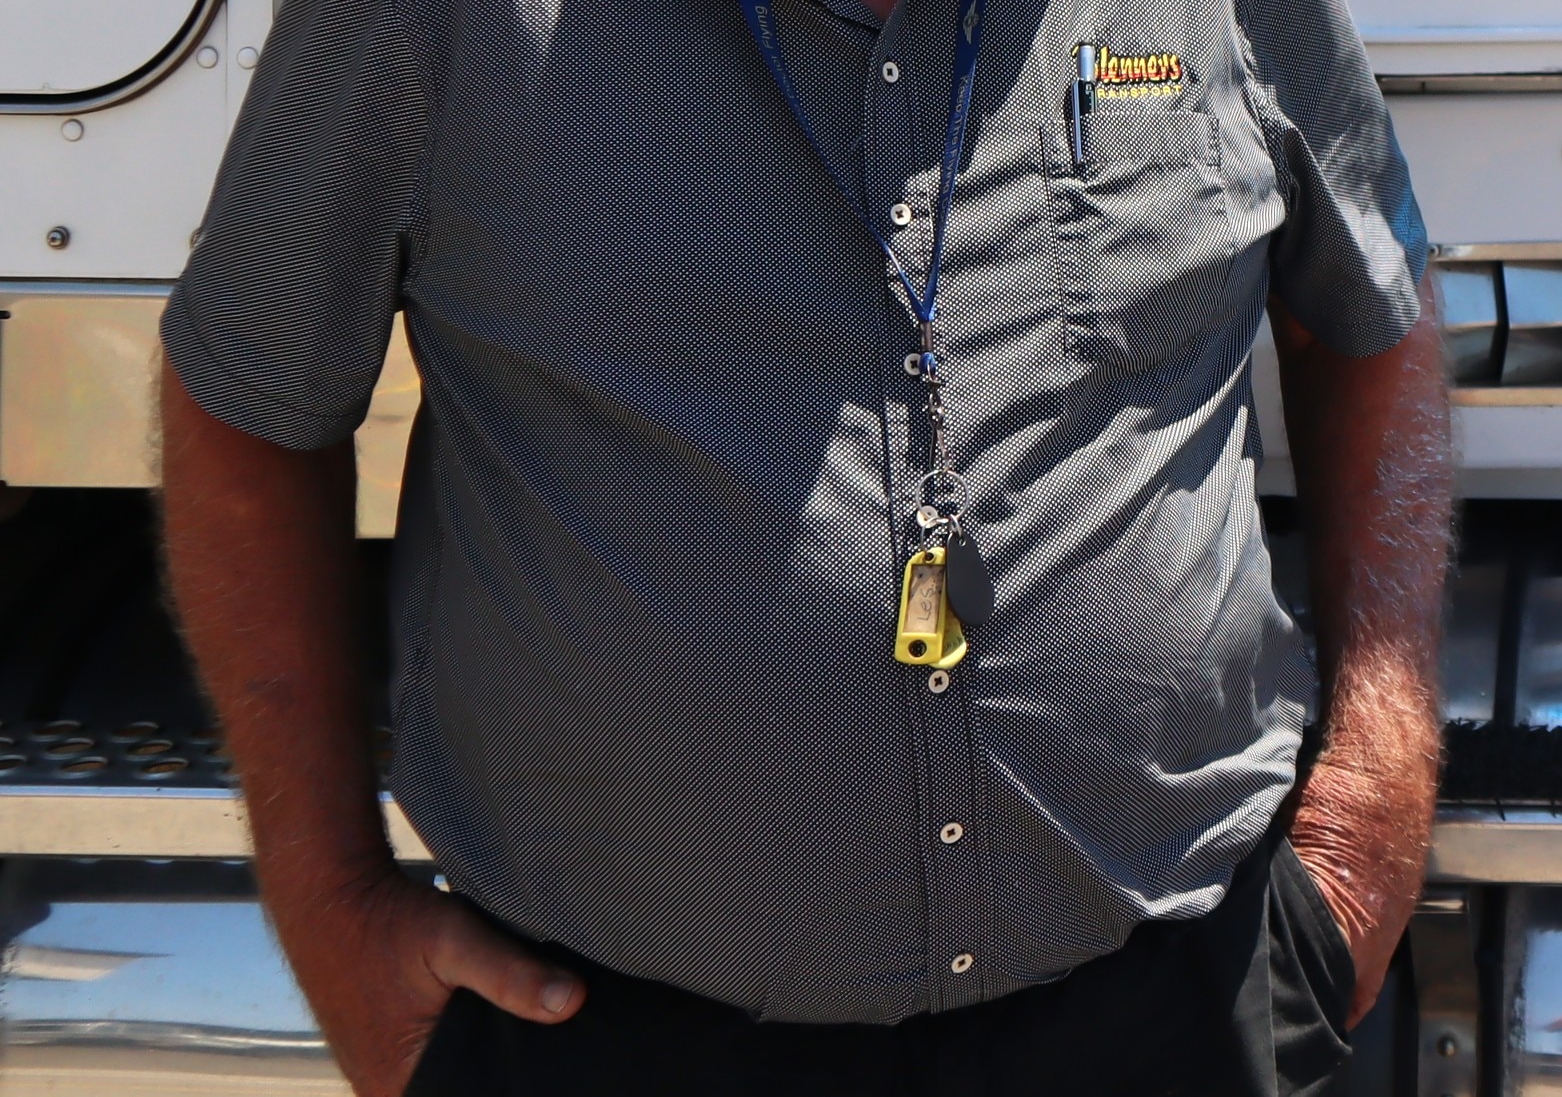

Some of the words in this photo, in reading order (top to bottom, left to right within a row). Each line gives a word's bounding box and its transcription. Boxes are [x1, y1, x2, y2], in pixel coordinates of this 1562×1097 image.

[755, 5, 775, 50] Flying
[1072, 45, 1183, 84] lenners
[1096, 85, 1183, 98] RANSPORT
[942, 149, 957, 194] Flying
